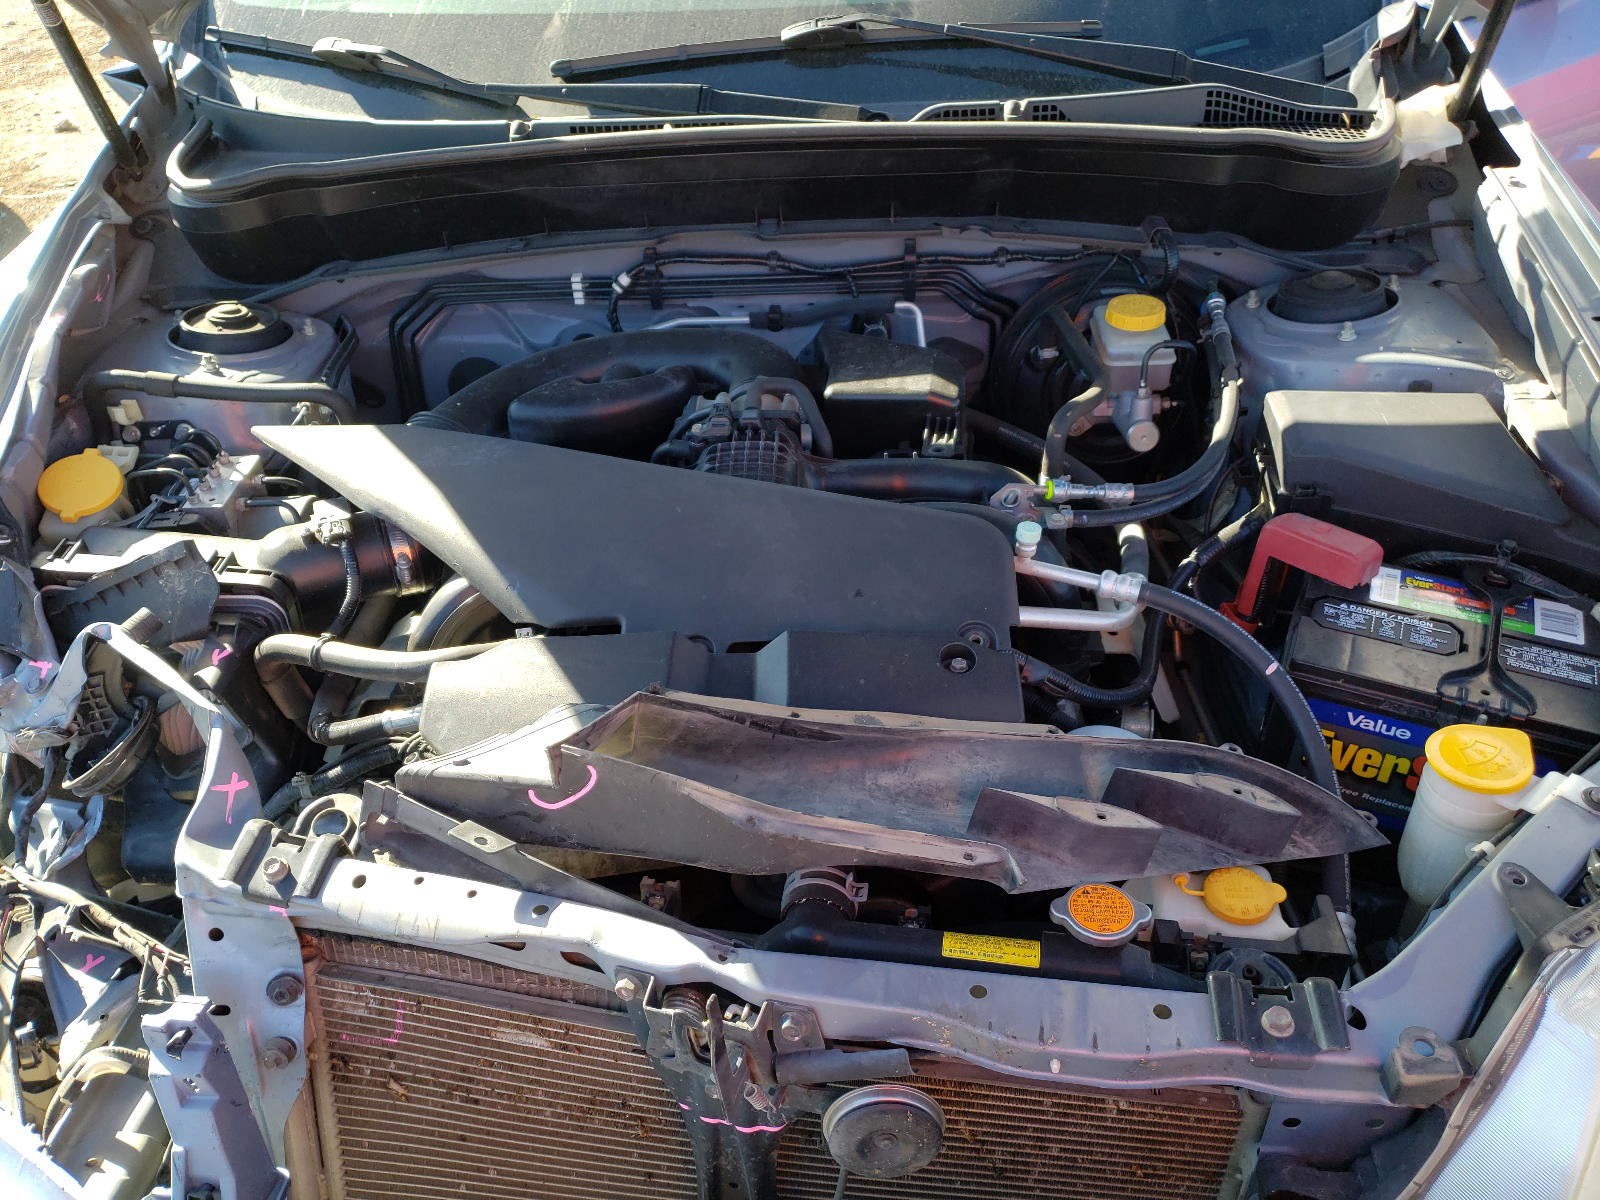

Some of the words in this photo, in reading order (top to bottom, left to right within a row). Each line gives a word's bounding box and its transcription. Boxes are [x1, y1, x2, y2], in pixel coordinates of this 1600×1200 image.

[1406, 577, 1465, 595] EverStart
[1350, 604, 1388, 618] DANGER
[1397, 615, 1434, 628] POISON
[1347, 711, 1412, 740] Value
[1321, 728, 1427, 792] ver
[1340, 786, 1359, 797] ree
